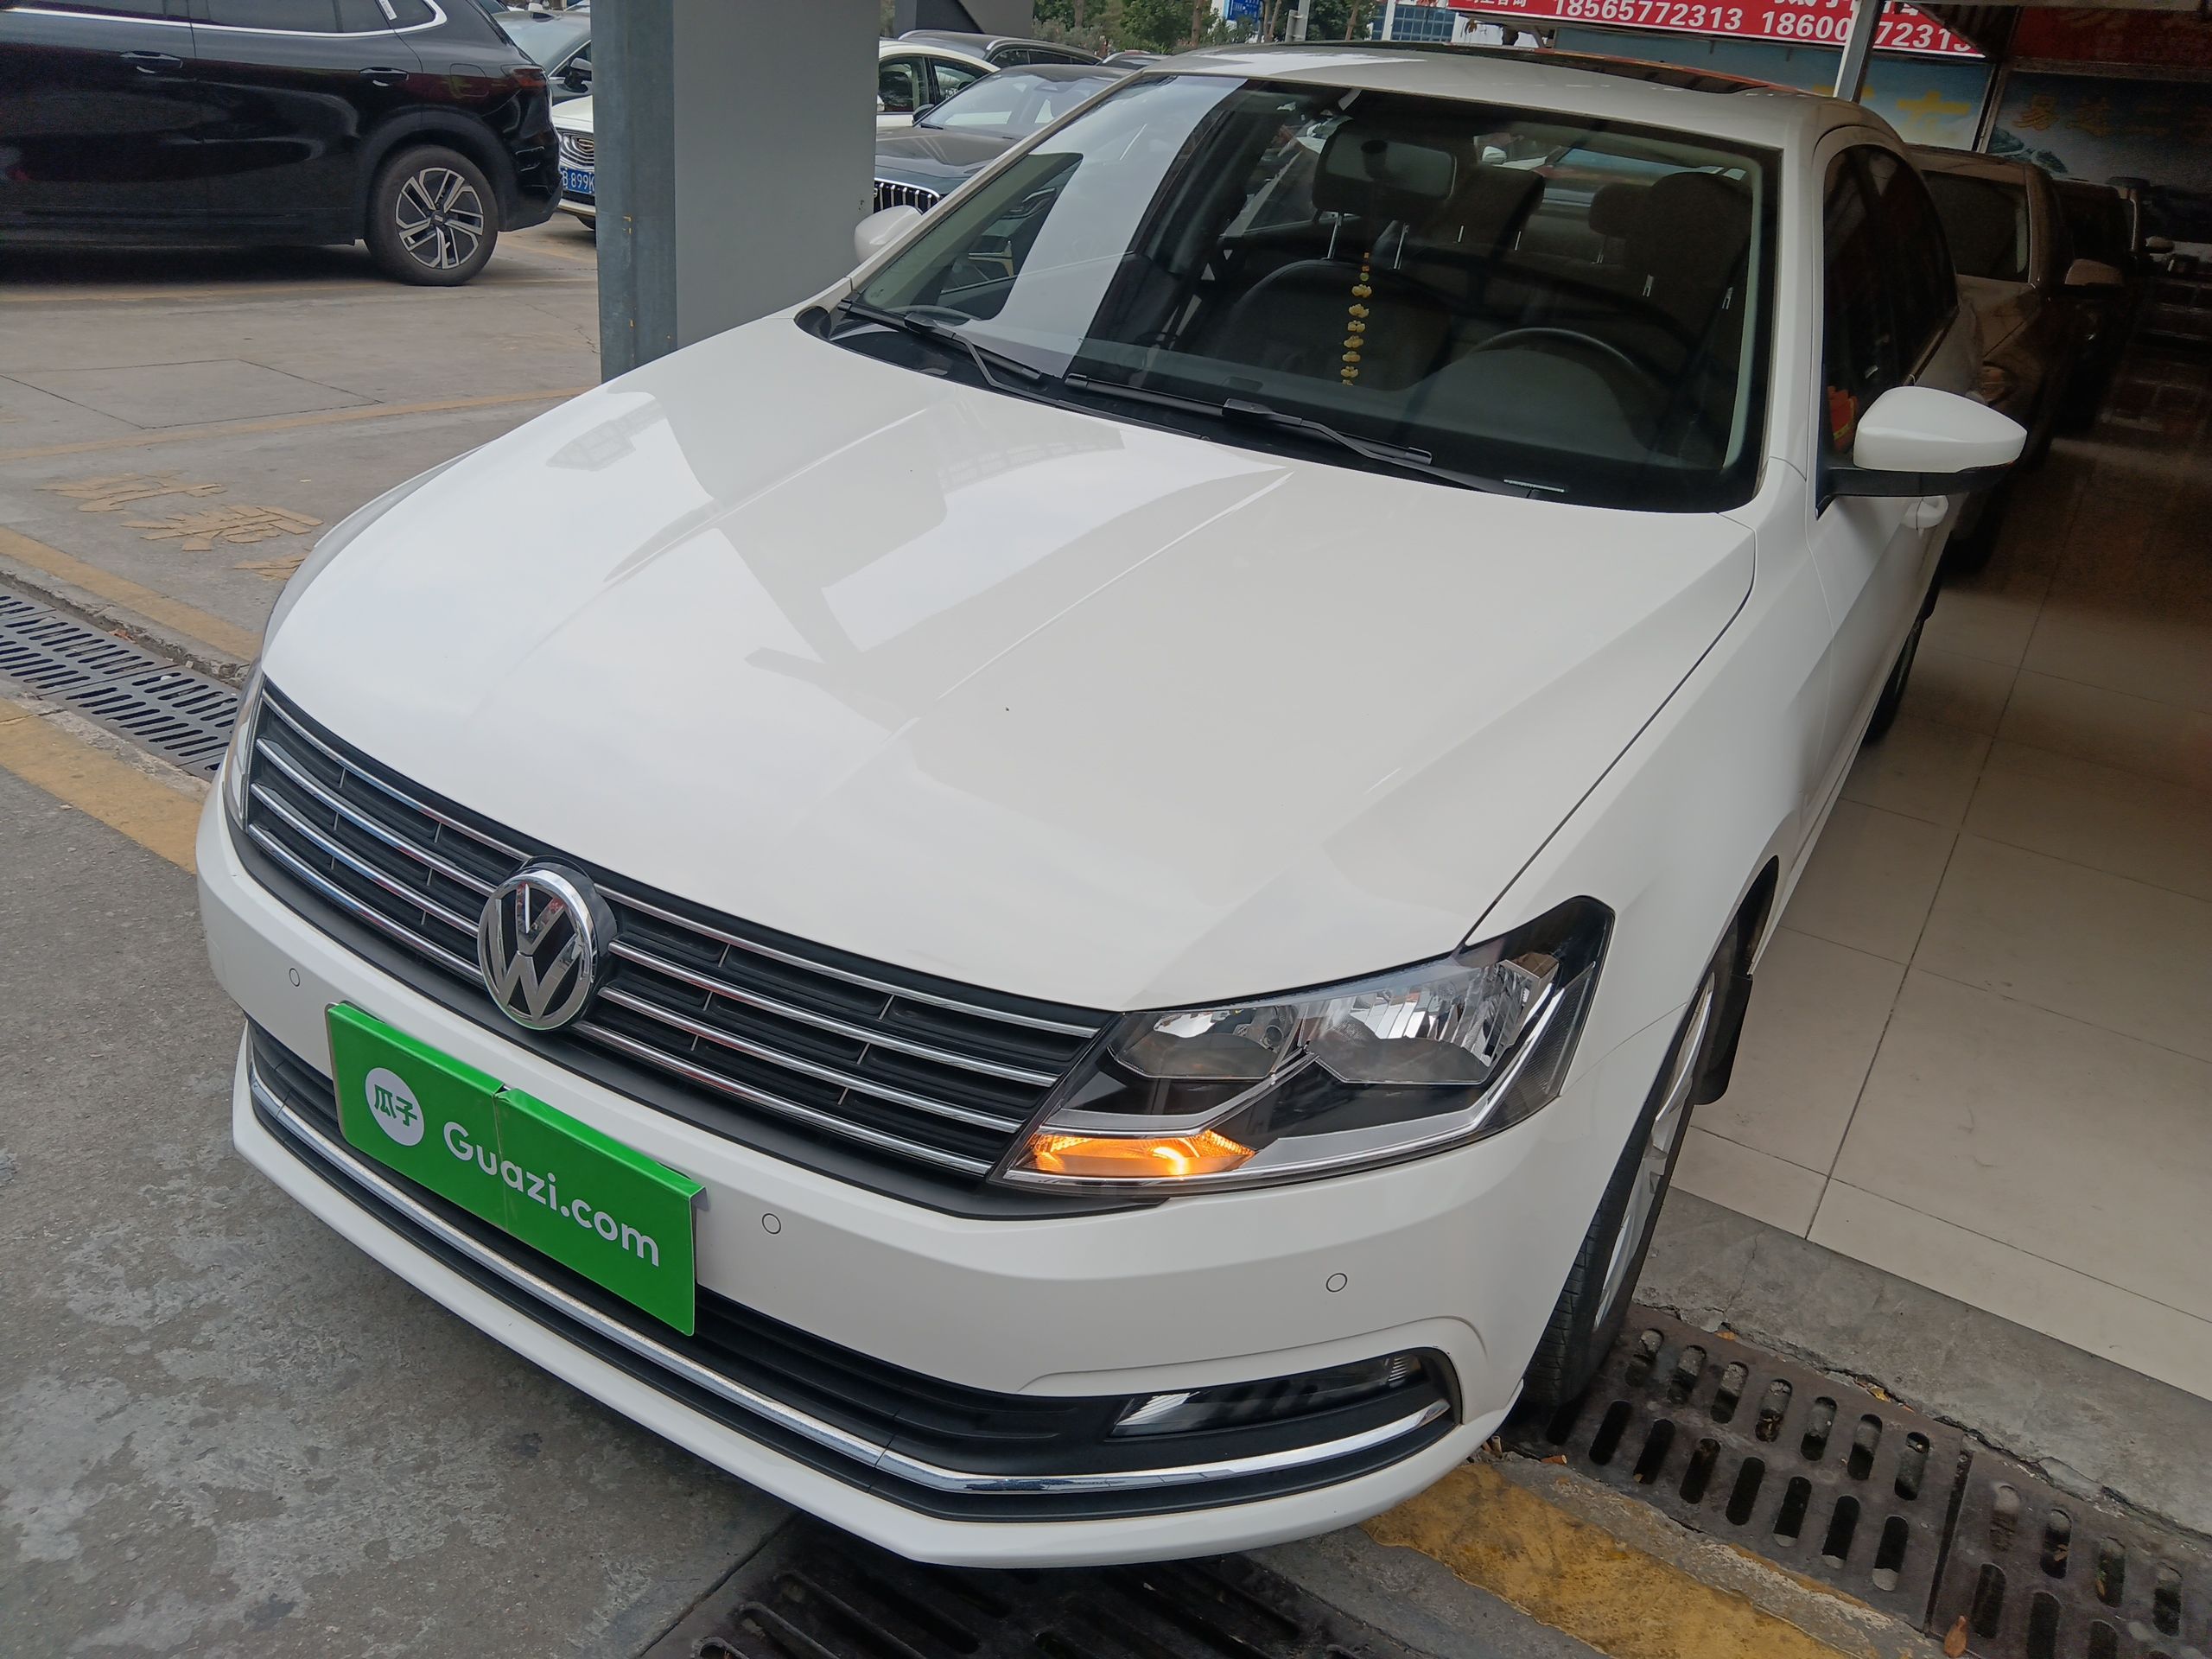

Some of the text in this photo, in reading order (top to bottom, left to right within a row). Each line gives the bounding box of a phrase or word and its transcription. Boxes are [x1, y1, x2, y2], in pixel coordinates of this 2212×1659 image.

[1555, 0, 1743, 30] 18565772313
[1762, 11, 1971, 52] 186007231
[374, 1084, 418, 1127] 瓜子
[443, 1122, 660, 1267] Guazi.com
